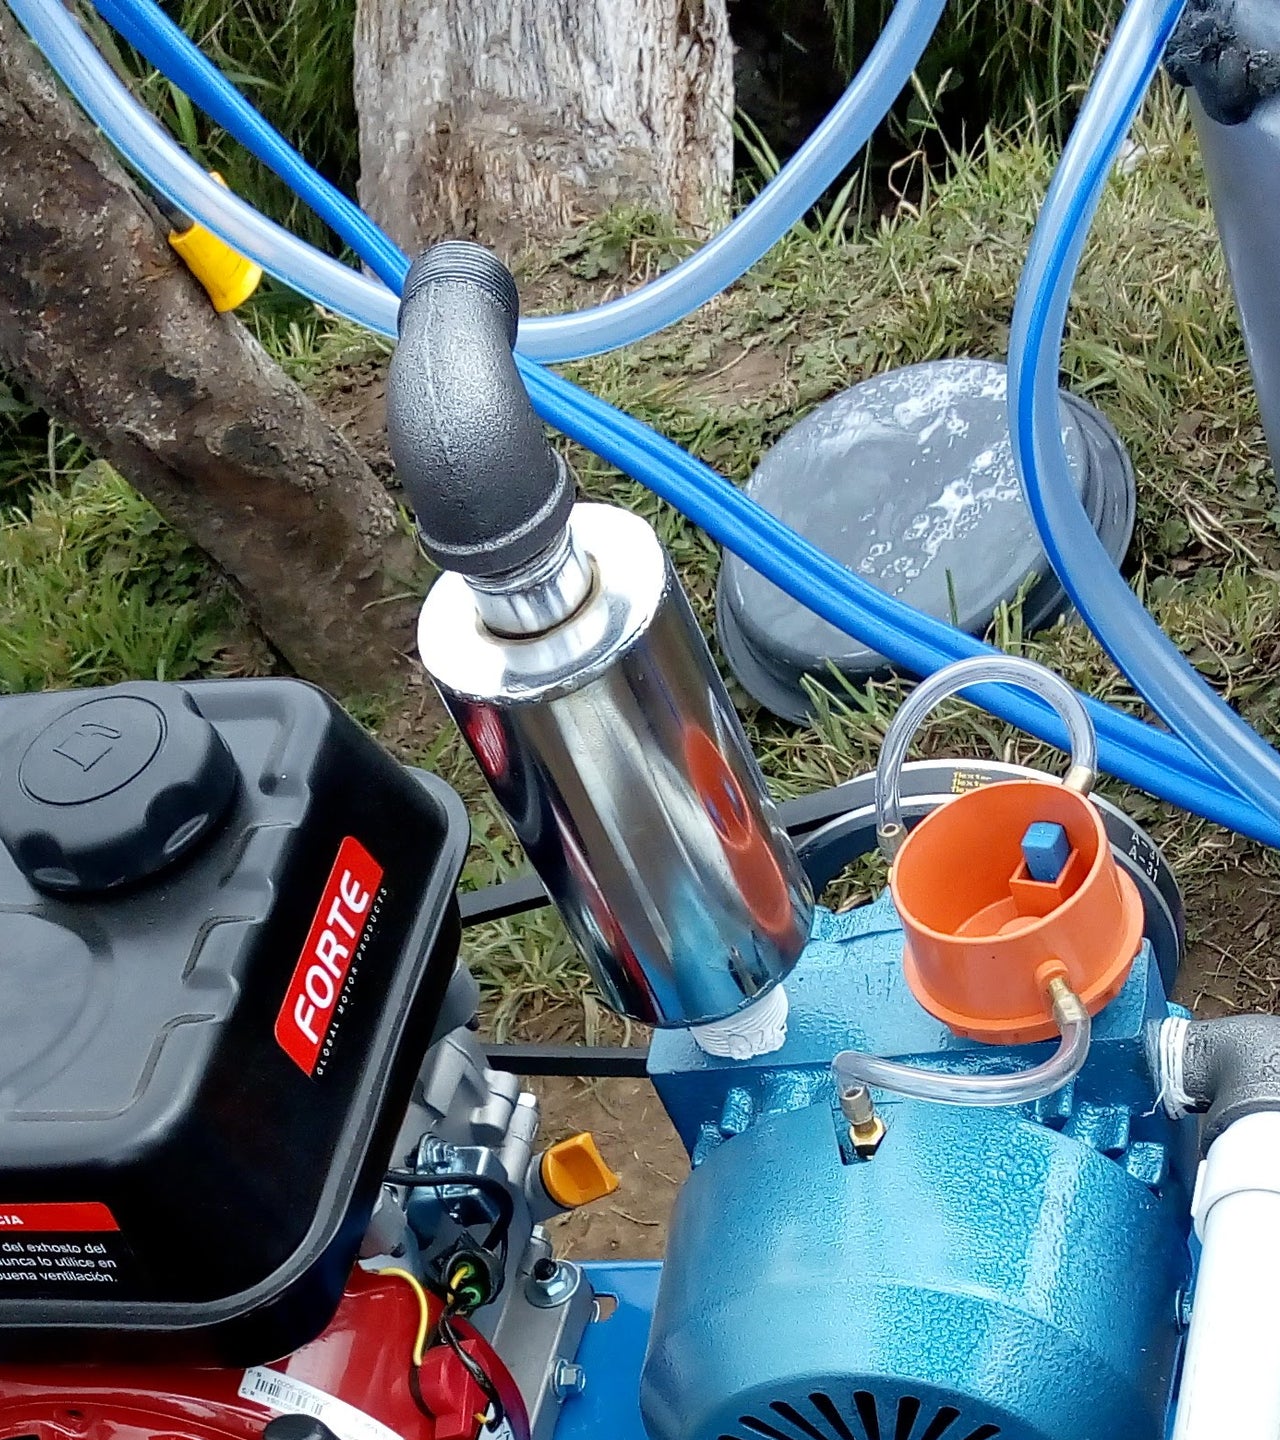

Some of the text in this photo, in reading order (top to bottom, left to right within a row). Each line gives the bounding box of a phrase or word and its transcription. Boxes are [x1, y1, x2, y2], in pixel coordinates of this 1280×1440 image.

[293, 868, 370, 1045] FORTE
[317, 887, 388, 1075] GLOBAL MOTOR PRODUCTS
[2, 1242, 24, 1253] del
[84, 1243, 107, 1254] del
[37, 1256, 52, 1267] lo
[55, 1257, 95, 1268] utilice
[98, 1259, 117, 1268] en
[39, 1271, 118, 1282] ventilación.
